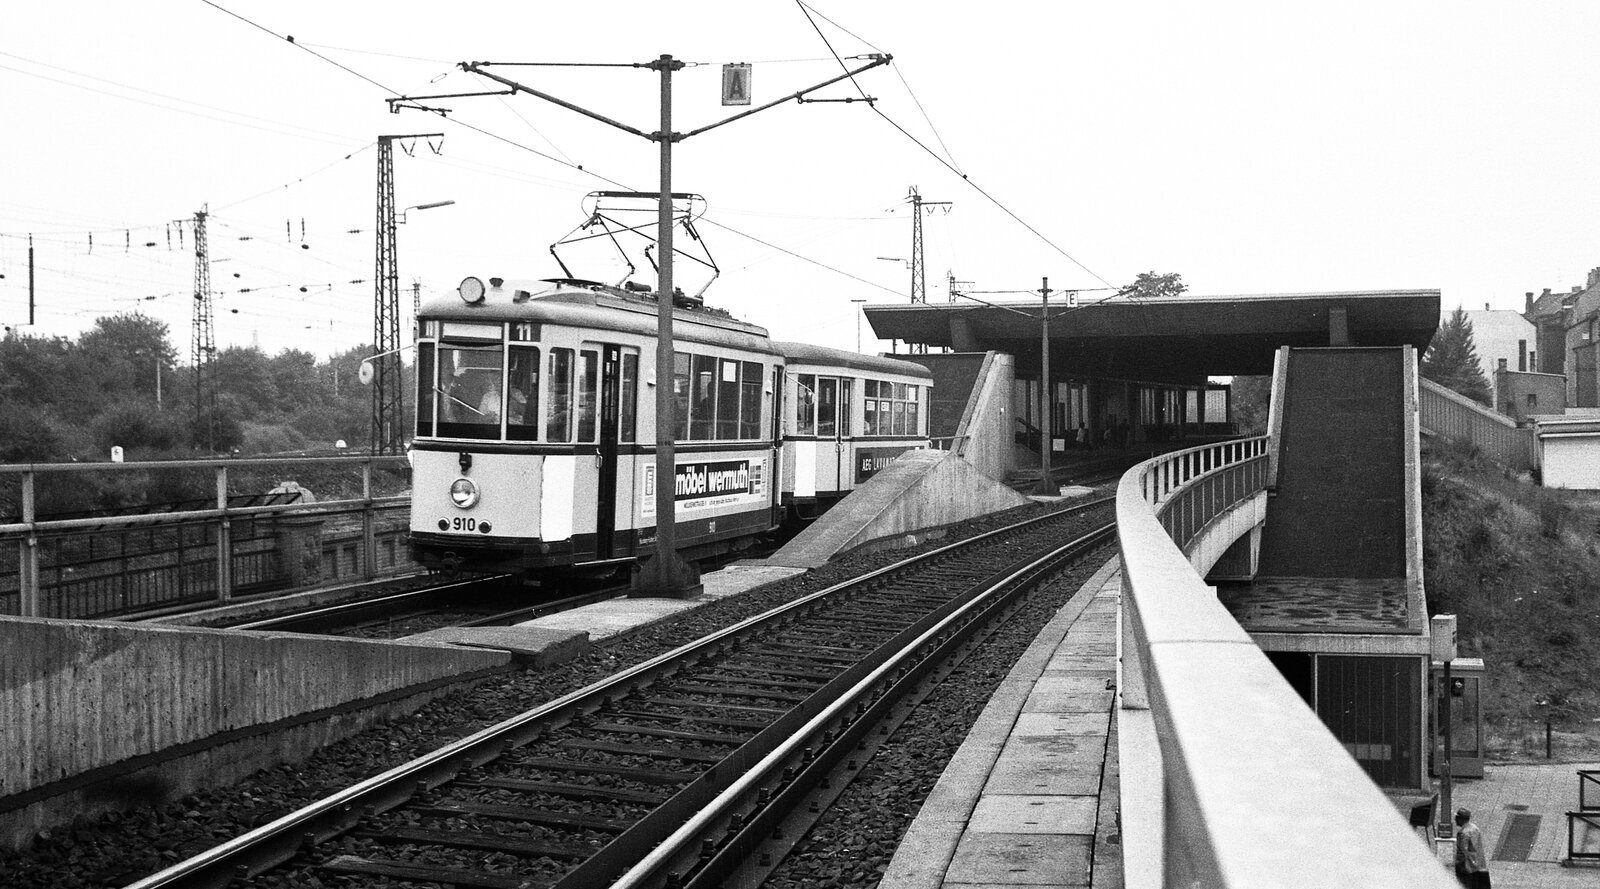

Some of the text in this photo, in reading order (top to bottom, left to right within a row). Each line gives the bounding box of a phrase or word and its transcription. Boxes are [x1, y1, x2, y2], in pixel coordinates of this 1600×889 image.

[729, 71, 745, 98] A
[1069, 293, 1075, 305] E
[516, 323, 532, 341] 11
[861, 458, 872, 471] AEG
[675, 465, 708, 496] möbel
[708, 463, 748, 492] wermuth
[453, 516, 476, 532] 910
